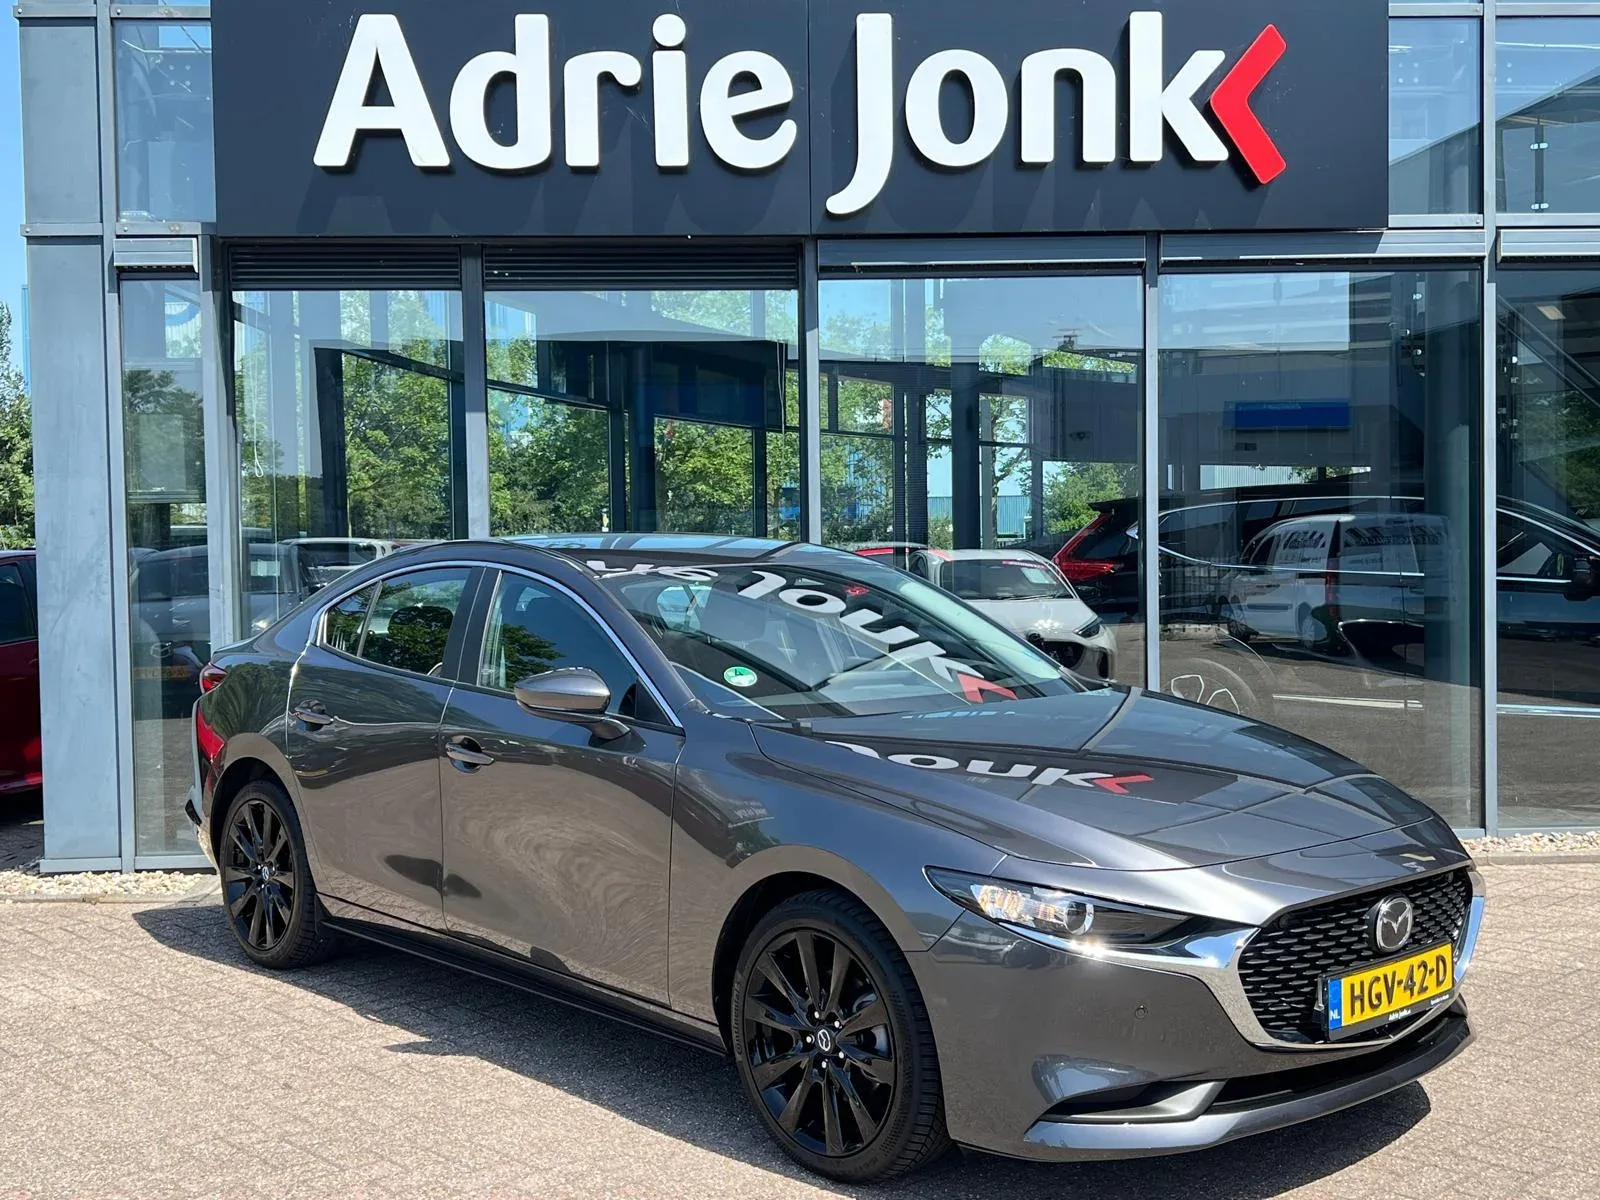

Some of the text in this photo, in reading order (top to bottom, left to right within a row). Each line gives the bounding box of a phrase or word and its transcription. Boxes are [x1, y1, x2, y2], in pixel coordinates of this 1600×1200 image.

[313, 11, 1230, 215] Adrie Jonk
[1329, 1009, 1341, 1020] NL
[1350, 954, 1447, 1017] HGV-42-D
